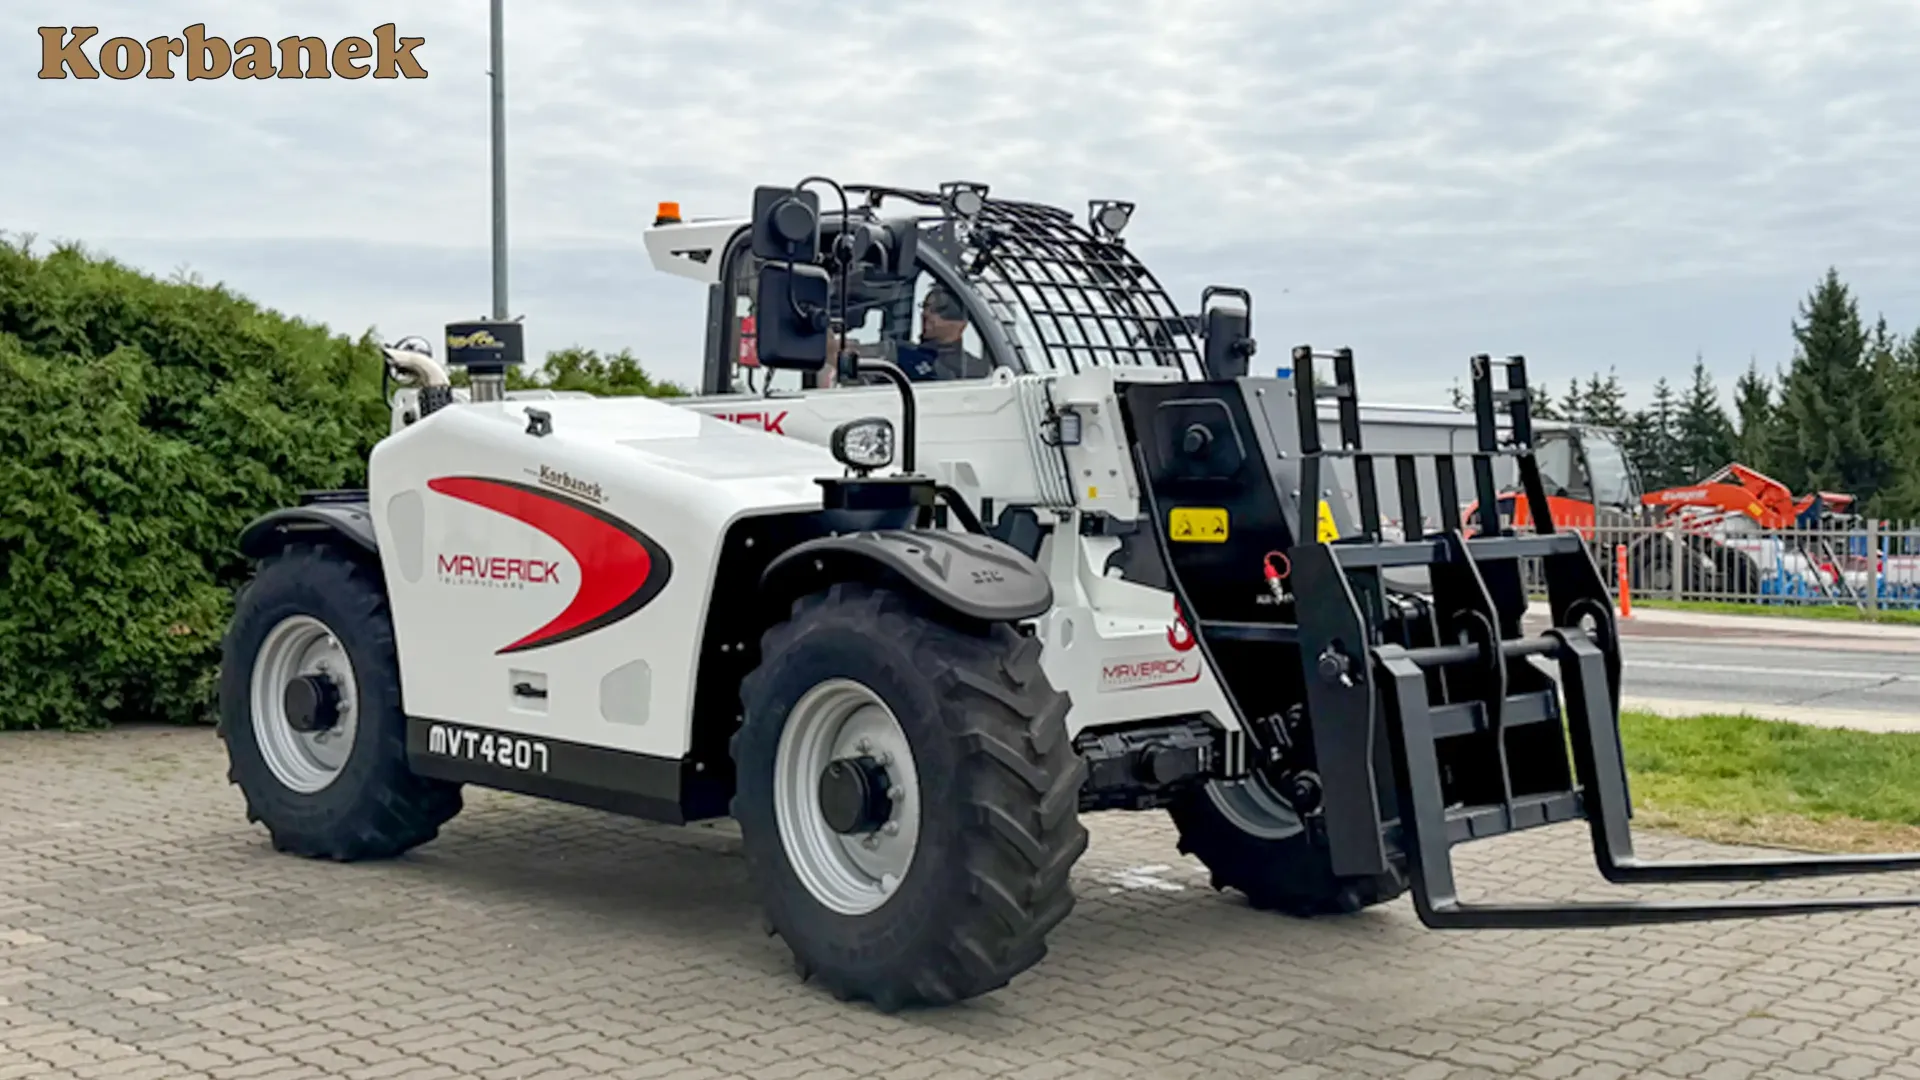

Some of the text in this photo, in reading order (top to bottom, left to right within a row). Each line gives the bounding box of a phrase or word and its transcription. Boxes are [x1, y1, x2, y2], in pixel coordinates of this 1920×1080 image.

[540, 464, 602, 498] Korbanek
[437, 553, 560, 584] MAVERICK
[1102, 658, 1185, 679] MAVERICK
[428, 724, 548, 773] MVT4207
